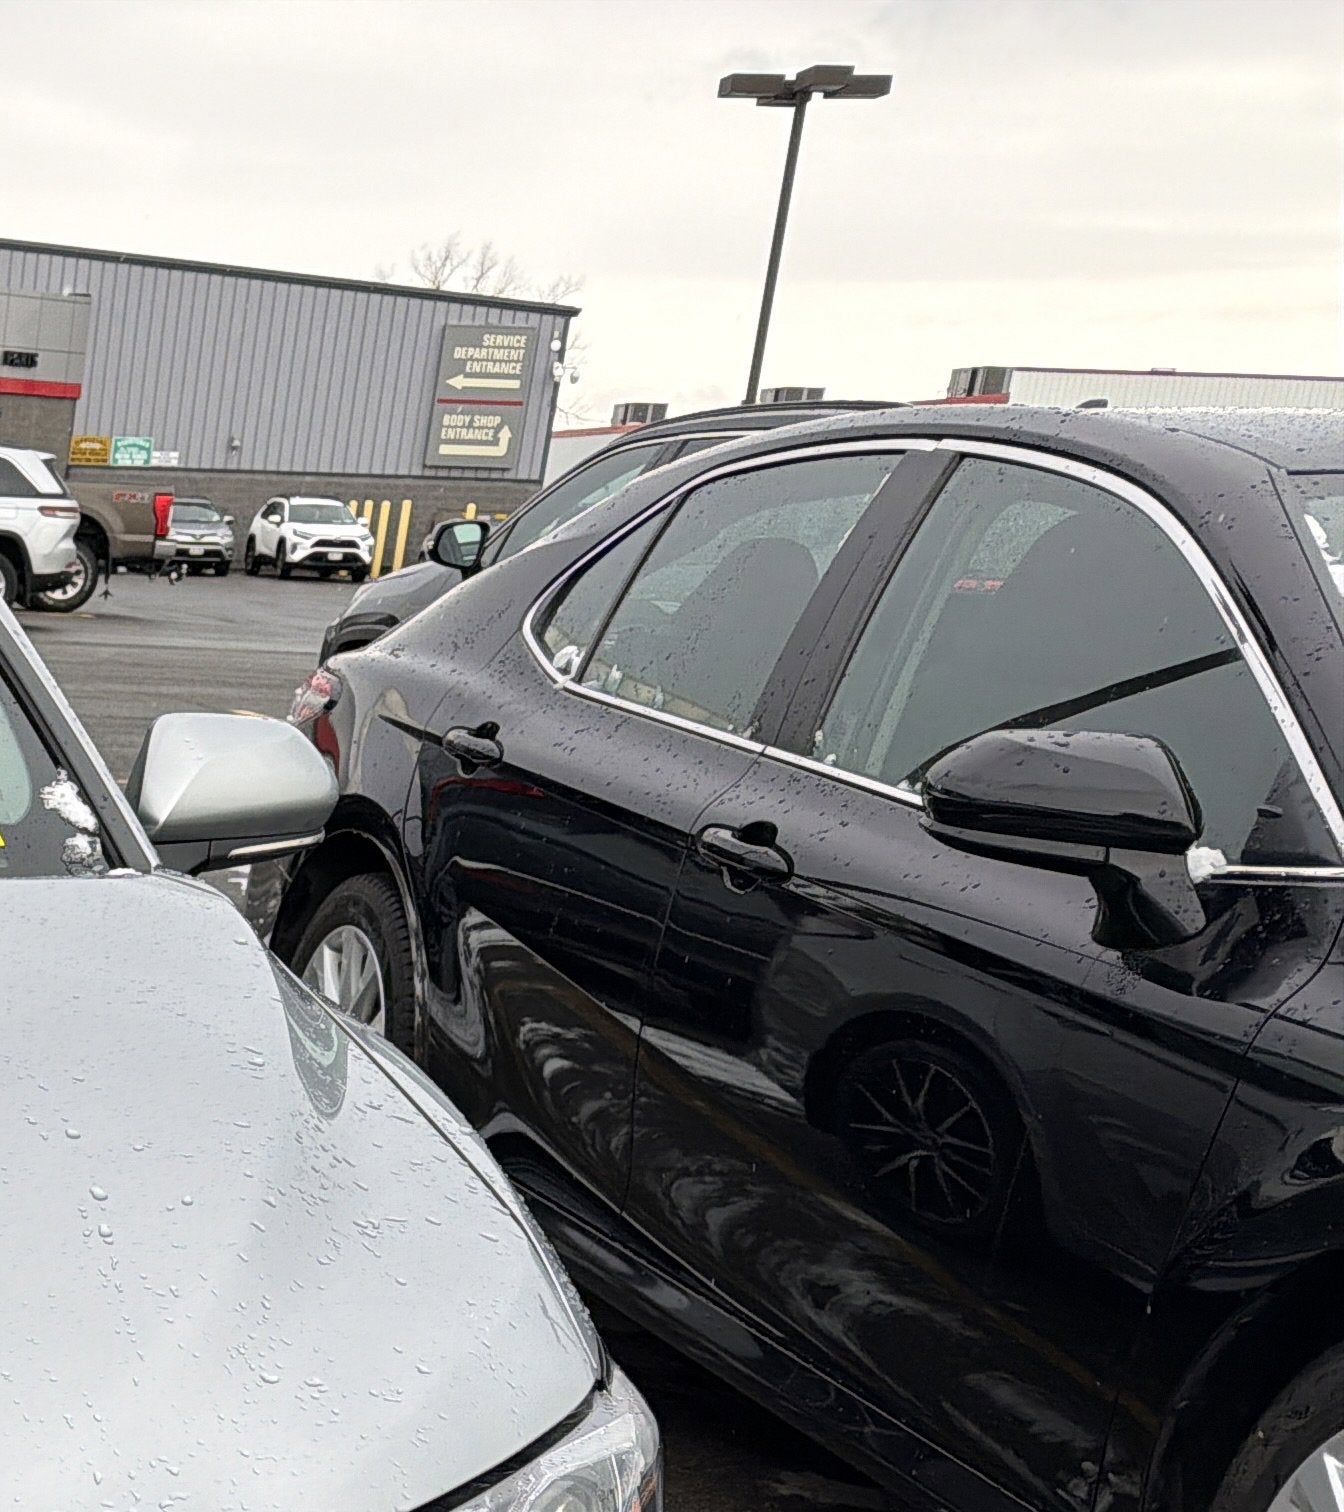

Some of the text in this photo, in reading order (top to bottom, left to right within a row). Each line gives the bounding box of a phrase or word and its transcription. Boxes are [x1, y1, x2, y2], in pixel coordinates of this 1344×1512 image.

[482, 333, 528, 348] SERVICE
[453, 346, 526, 361] DEPARTMENT
[465, 360, 524, 375] ENTRANCE
[442, 413, 502, 428] BODY SHOP
[440, 427, 495, 440] ENTRANCE
